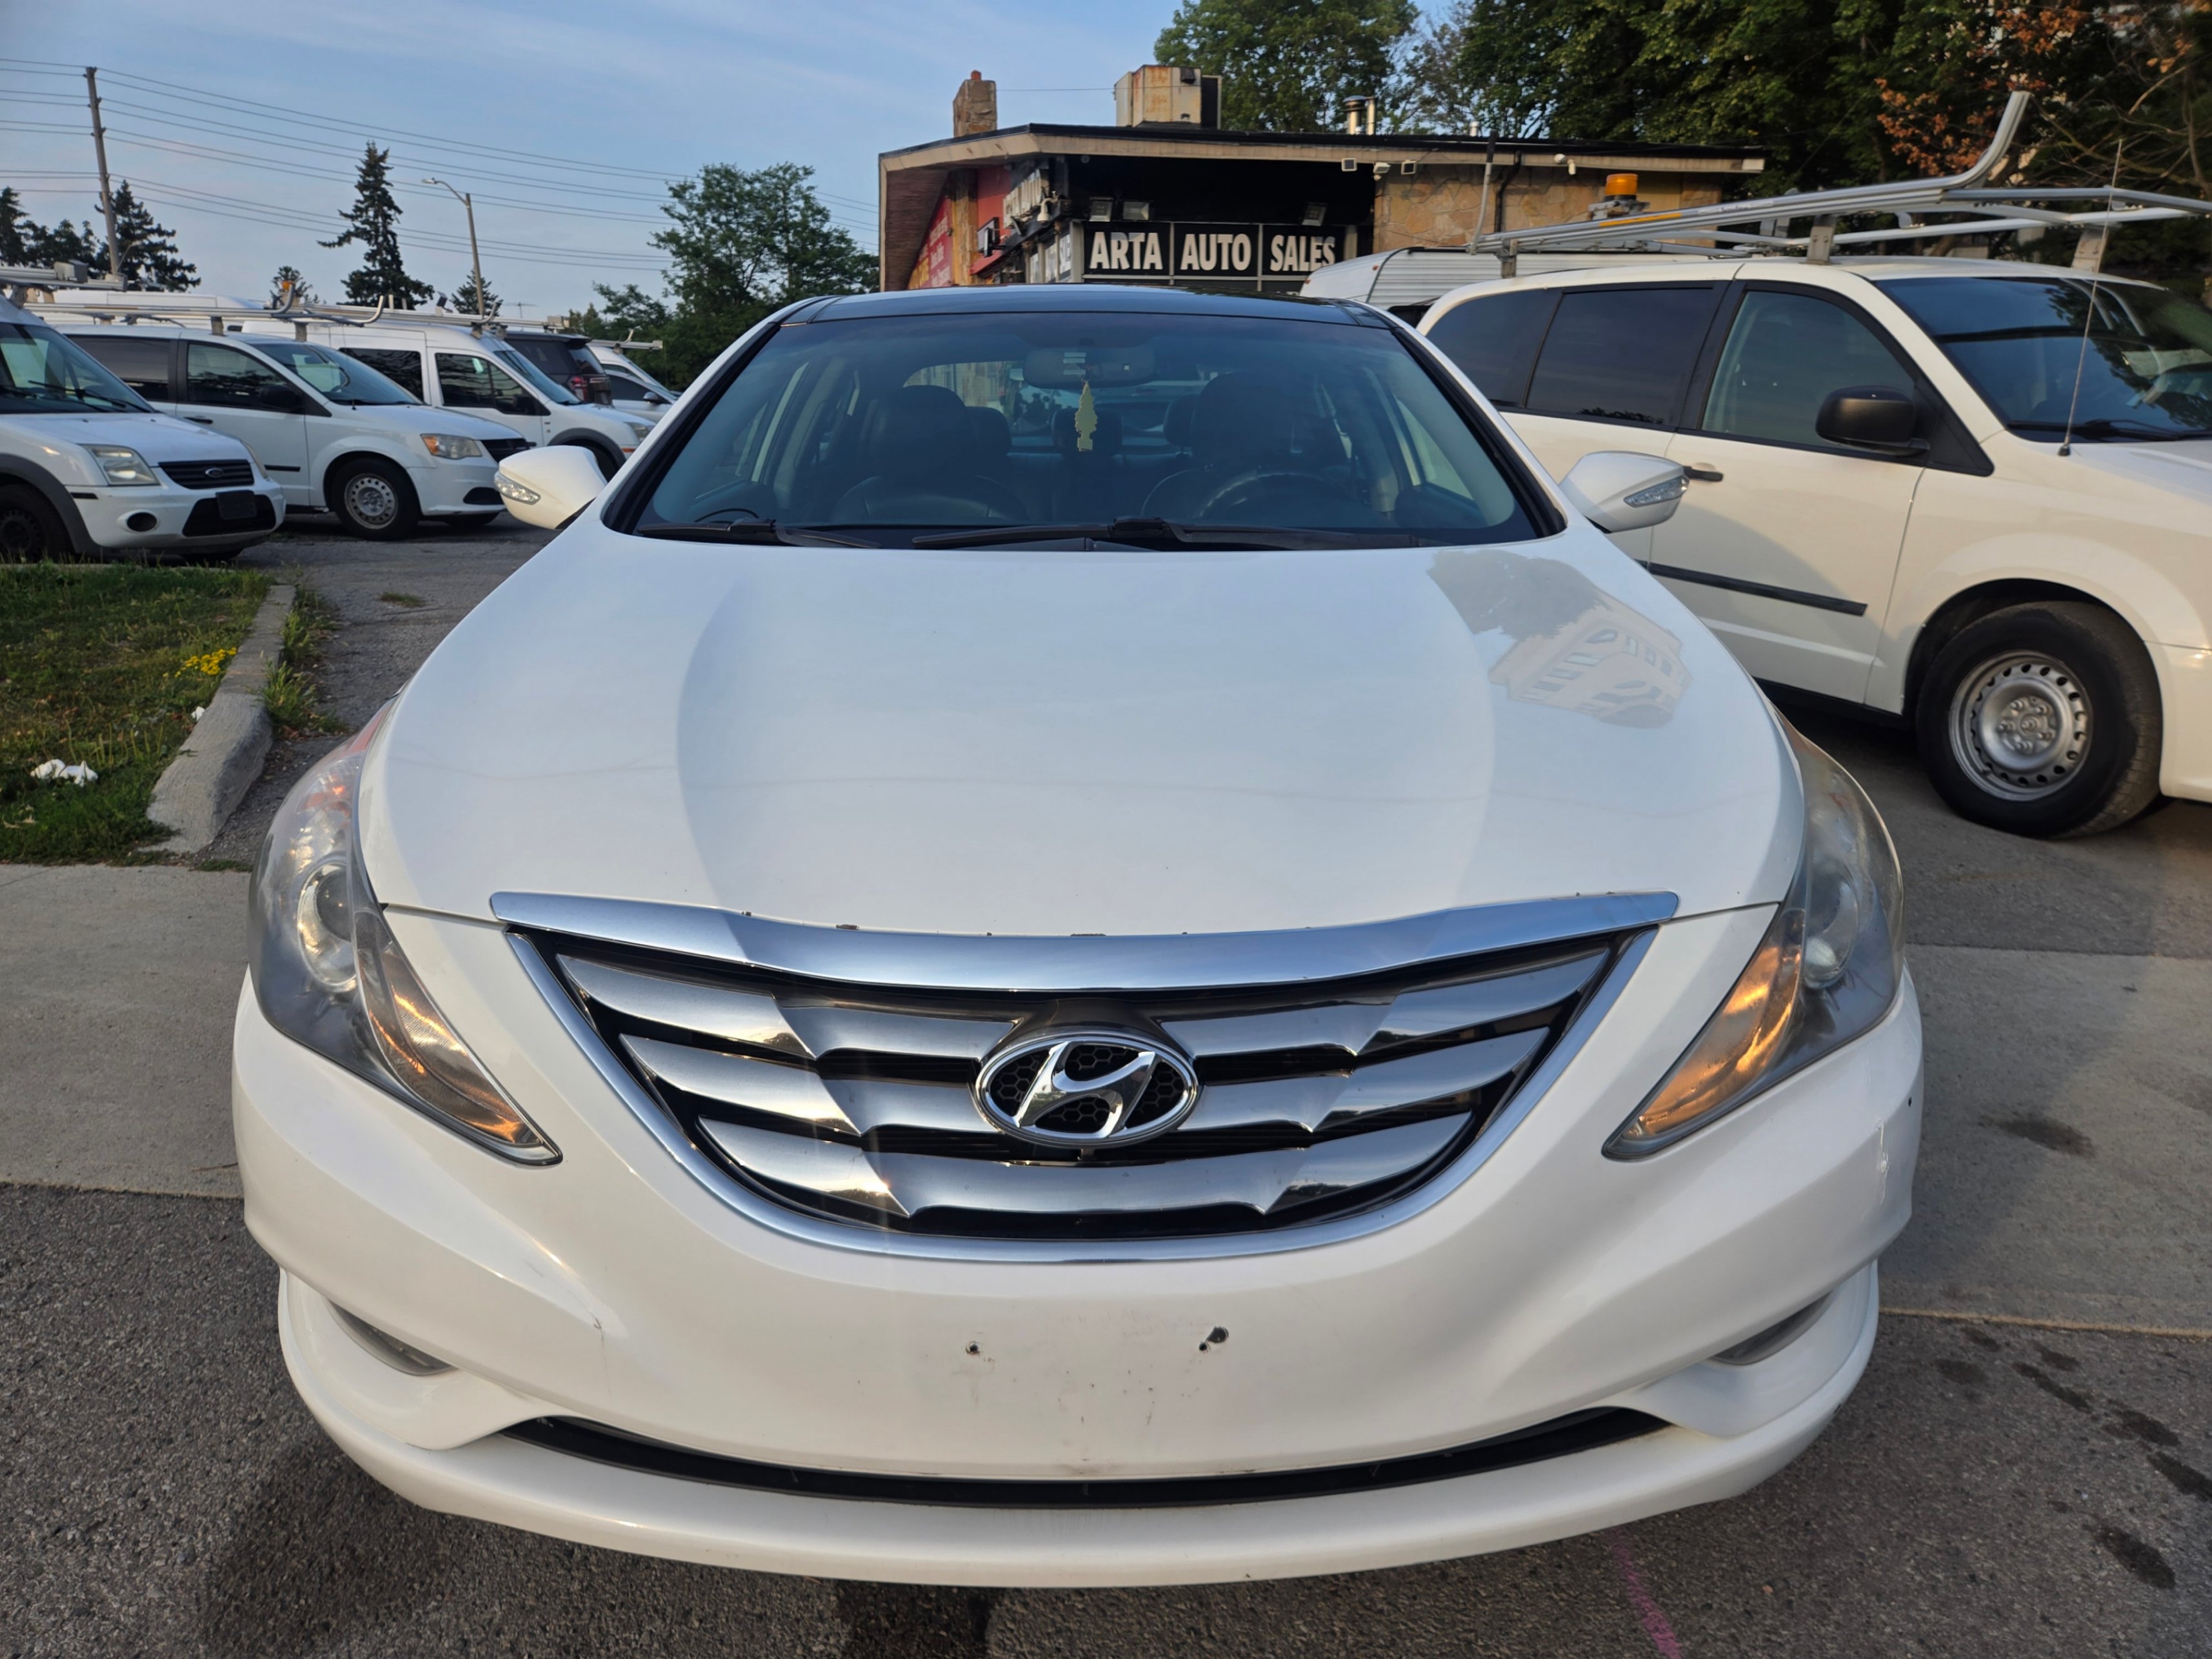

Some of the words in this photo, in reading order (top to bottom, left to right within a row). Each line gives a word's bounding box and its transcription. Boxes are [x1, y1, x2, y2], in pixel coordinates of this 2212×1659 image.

[1090, 232, 1163, 270] ARTA
[1180, 234, 1252, 271] AUTO
[1270, 234, 1336, 272] SALES
